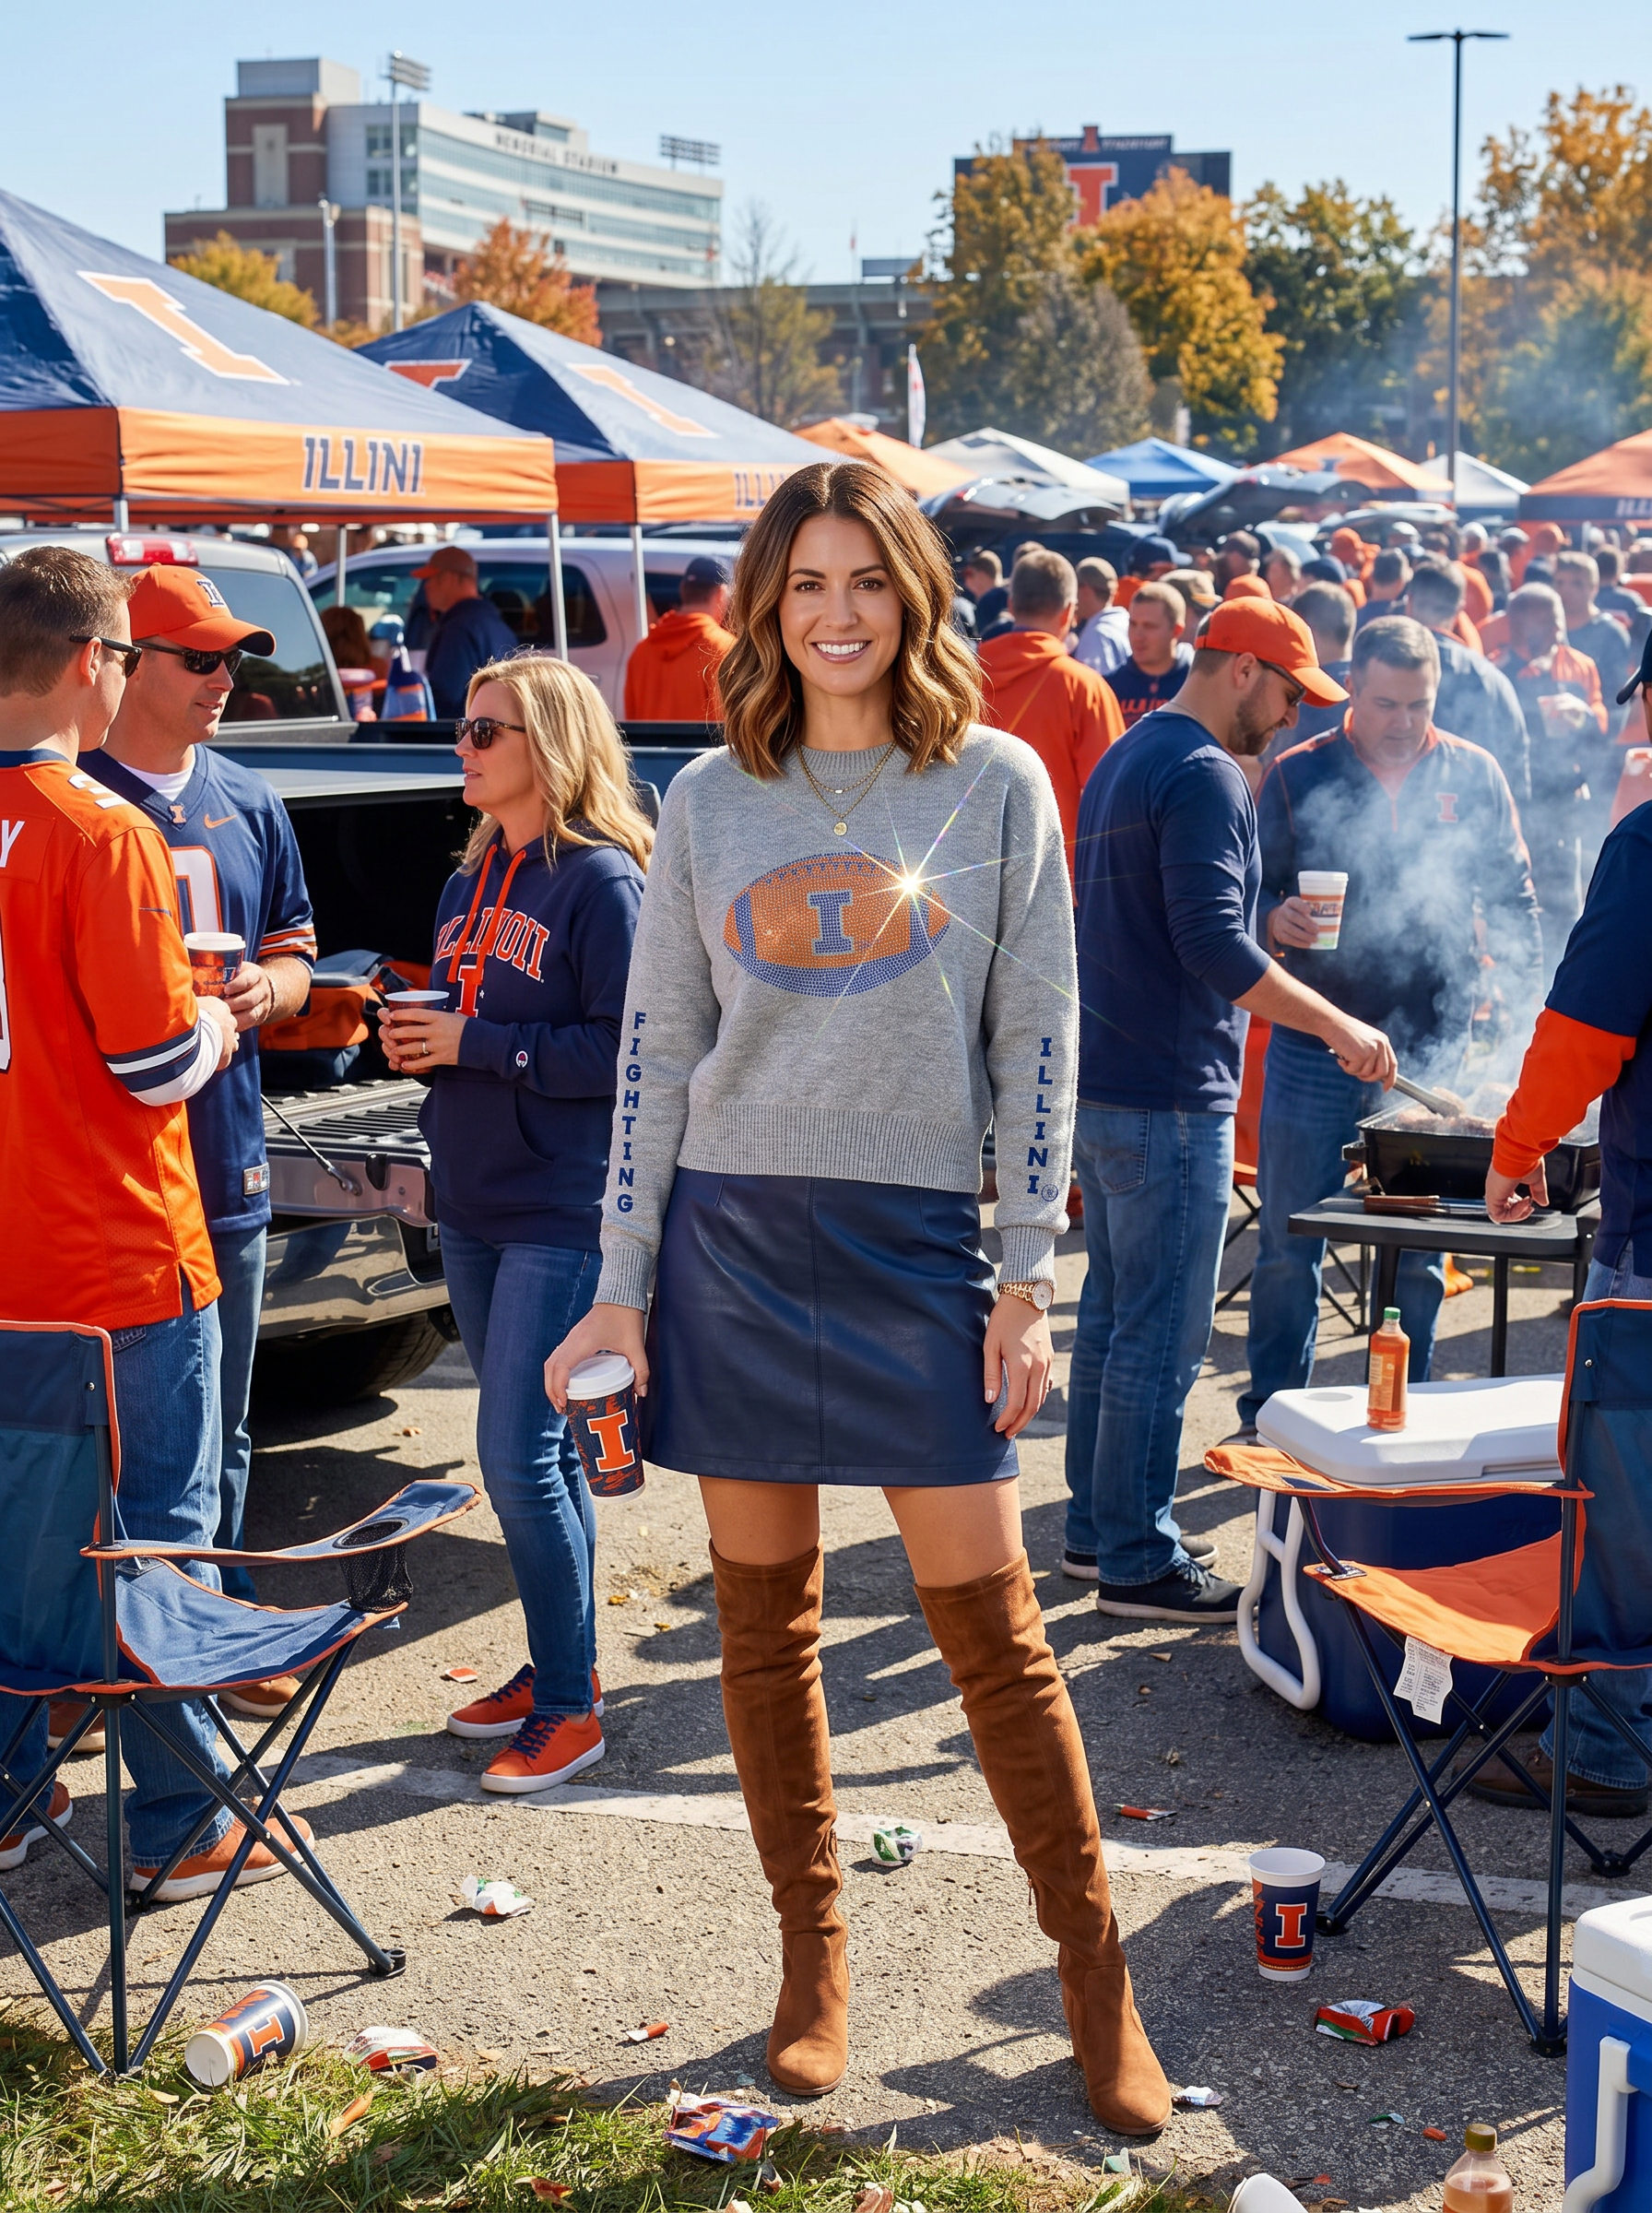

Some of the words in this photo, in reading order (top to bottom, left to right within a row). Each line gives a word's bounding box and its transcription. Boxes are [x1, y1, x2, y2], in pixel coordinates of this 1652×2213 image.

[303, 433, 423, 495] ILLINI
[734, 470, 786, 508] ILLI
[1435, 792, 1458, 822] I
[808, 889, 855, 956] I
[617, 1011, 647, 1213] FIGHTING
[1027, 1036, 1054, 1195] ILLINI
[586, 1409, 636, 1473] I
[1275, 1902, 1308, 1948] I
[245, 2013, 285, 2058] I
